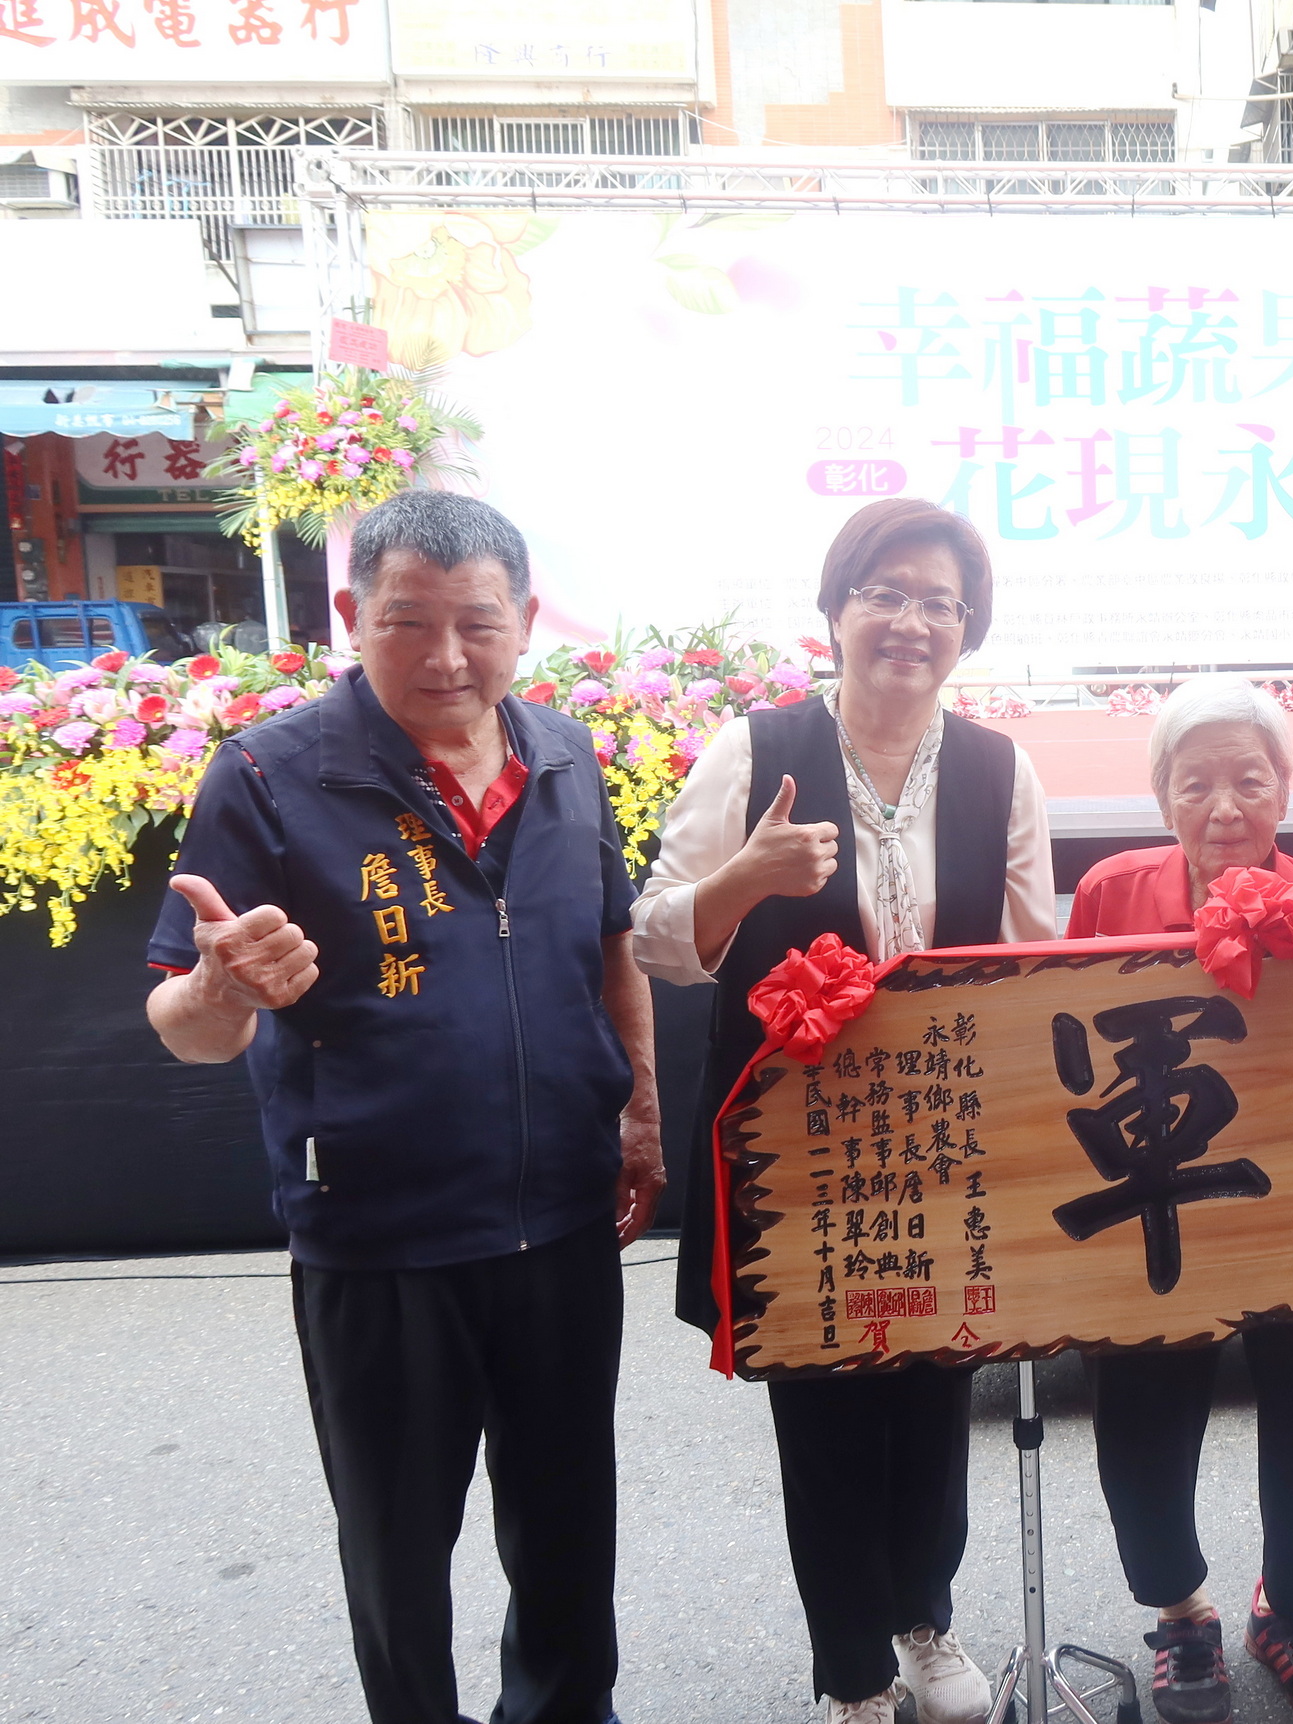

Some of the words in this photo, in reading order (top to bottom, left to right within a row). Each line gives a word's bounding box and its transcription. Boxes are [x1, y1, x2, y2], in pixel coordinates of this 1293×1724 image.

[158, 488, 209, 502] TEL
[815, 425, 896, 451] 2024
[823, 463, 890, 493] 彰化
[360, 852, 426, 998] 詹日新
[394, 812, 455, 917] 理事長
[833, 1048, 876, 1280] 總幹事陳翠玲
[864, 1047, 903, 1280] 常務監事邱創典
[895, 1050, 934, 1282] 理事長詹日新
[923, 1016, 963, 1185] 永靖鄉農會
[951, 1012, 993, 1281] 彰化縣長王惠美
[858, 1320, 891, 1354] 賀
